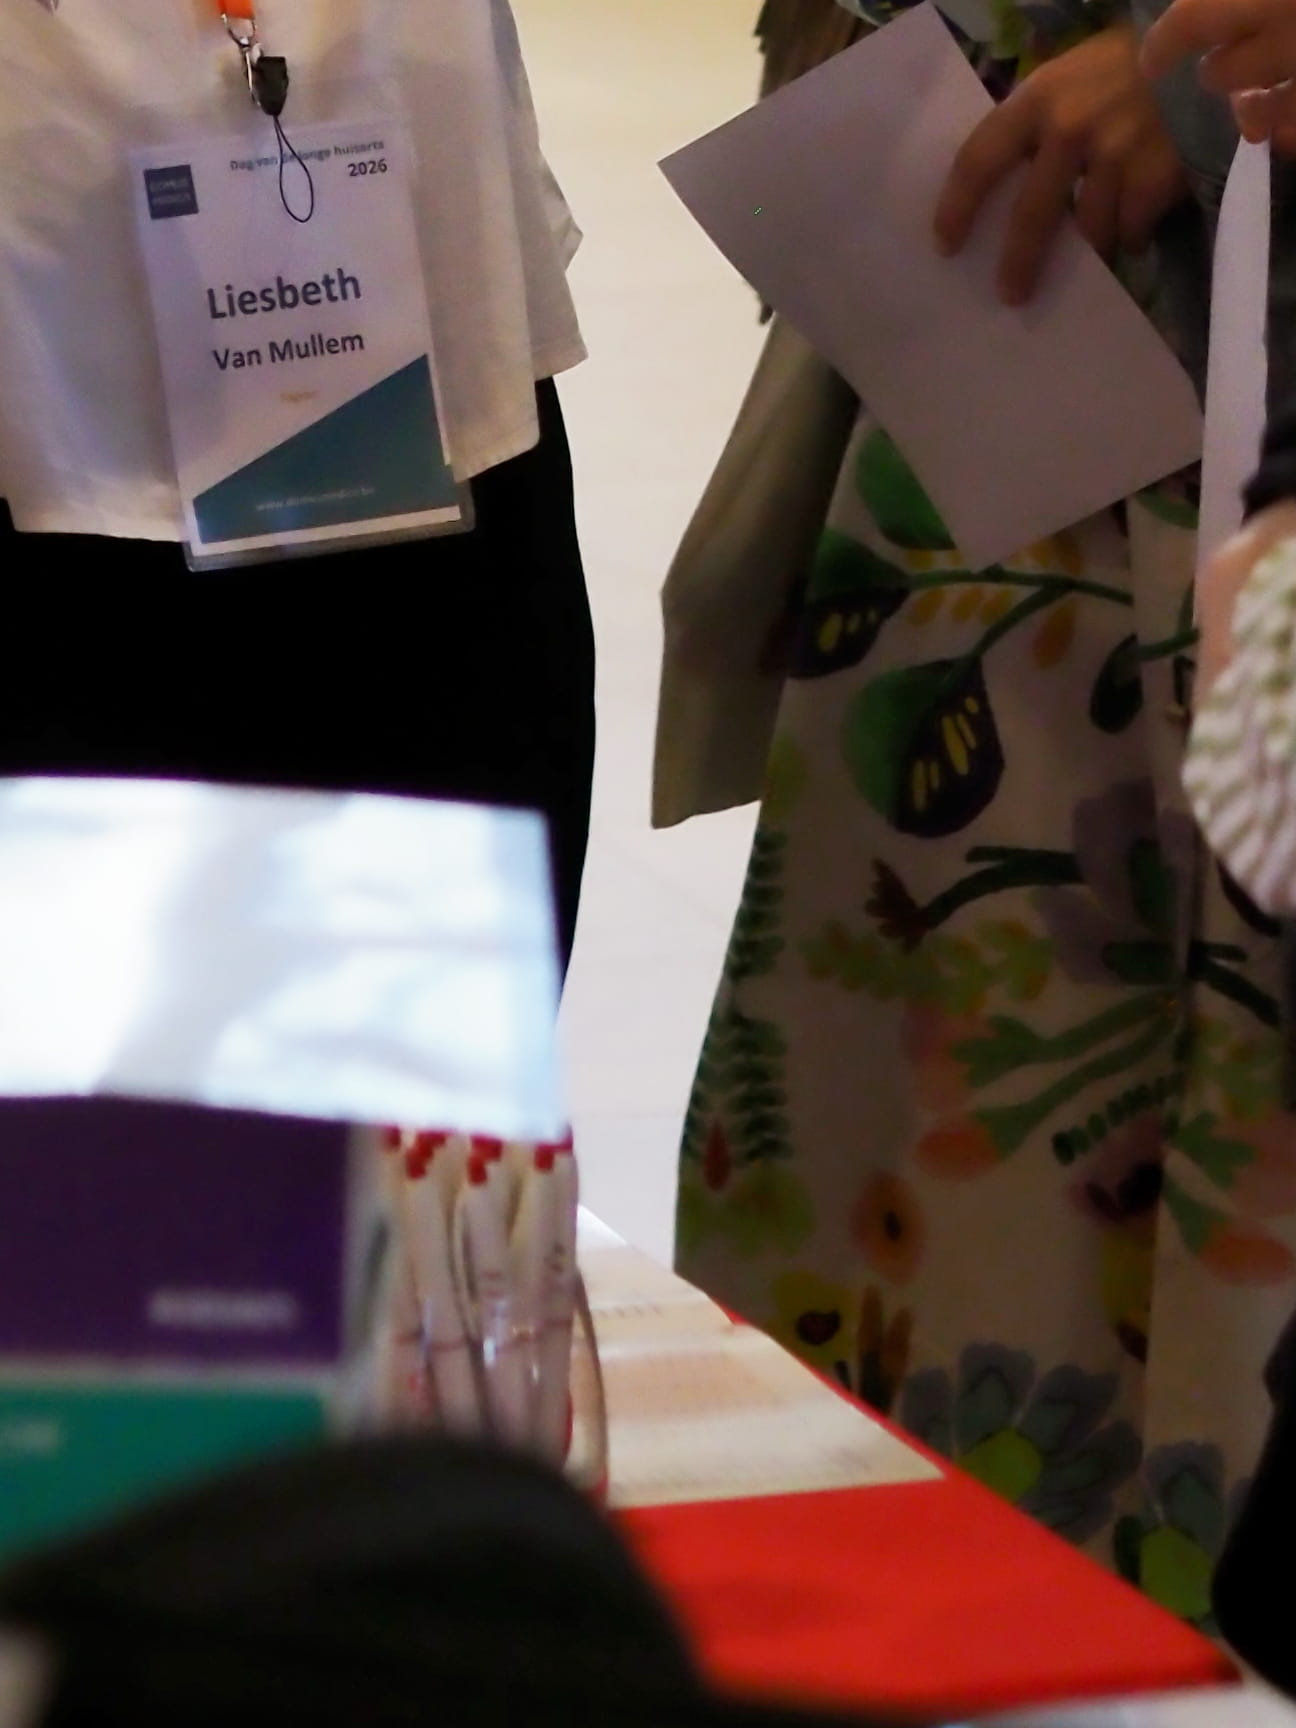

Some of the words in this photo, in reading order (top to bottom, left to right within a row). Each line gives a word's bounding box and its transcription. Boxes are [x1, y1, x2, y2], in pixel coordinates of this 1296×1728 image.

[347, 158, 388, 177] 2026
[207, 267, 361, 320] Liesbeth
[213, 344, 263, 372] Van
[269, 329, 365, 365] Mullem
